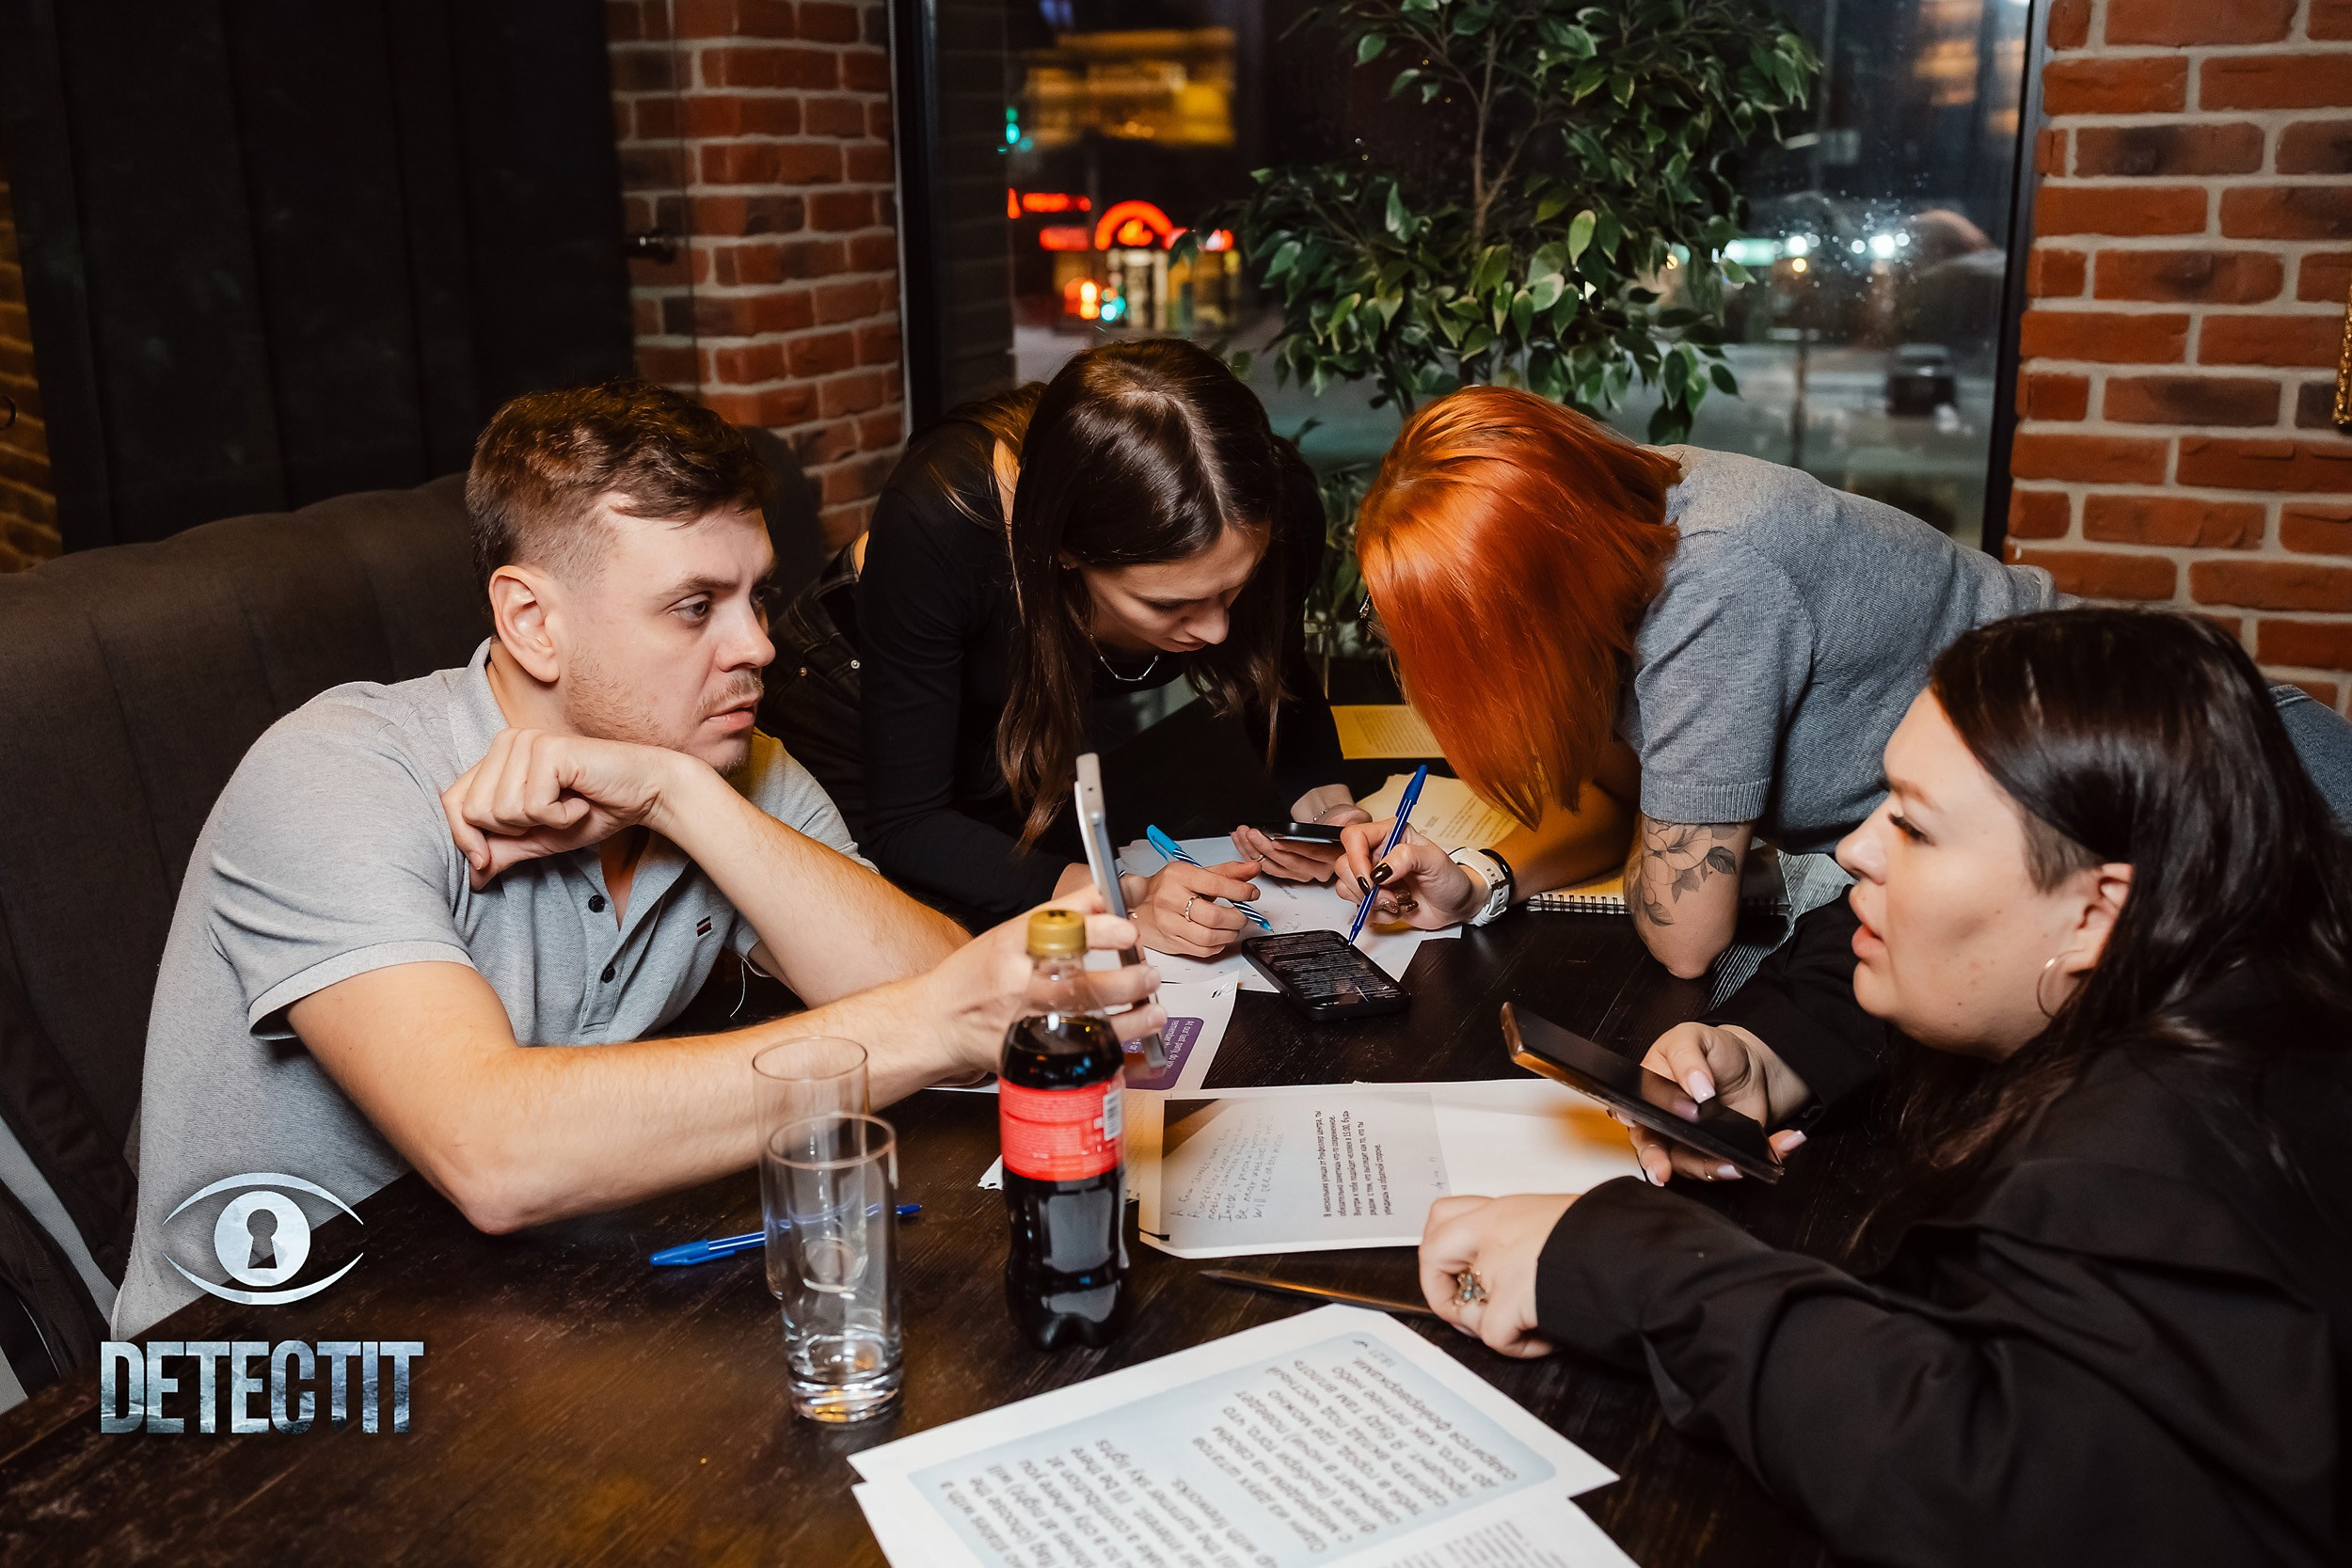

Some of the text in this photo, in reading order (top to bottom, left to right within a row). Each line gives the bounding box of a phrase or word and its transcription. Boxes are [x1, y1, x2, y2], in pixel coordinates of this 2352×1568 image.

[1164, 1021, 1180, 1042] remember
[1178, 1034, 1189, 1042] last
[1315, 1118, 1324, 1135] центра,
[1342, 1111, 1350, 1122] будь
[1329, 1116, 1339, 1147] современное.
[1342, 1124, 1350, 1136] 15:00,
[1317, 1135, 1327, 1160] Рокфеллер
[1345, 1142, 1354, 1159] человек
[1374, 1144, 1384, 1163] стороне.
[1320, 1166, 1329, 1182] улицах
[1334, 1162, 1343, 1183] заметишь
[1347, 1160, 1358, 1180] подойдет
[1361, 1152, 1371, 1173] выглядит
[1375, 1163, 1387, 1183] обратной
[1323, 1183, 1331, 1212] нескольких
[1348, 1181, 1359, 1193] тебе
[1235, 1209, 1249, 1220] Be
[1244, 1180, 1257, 1202] near
[1336, 1184, 1346, 1216] обязательно
[1353, 1197, 1362, 1215] Внутри
[1368, 1198, 1377, 1215] рядом
[1383, 1192, 1392, 1215] увидишь
[1294, 1360, 1470, 1498] процент. Я буду там вплоть
[1331, 1367, 1499, 1489] до того, как летнее небо
[1353, 1358, 1518, 1481] озарится фейерверками.
[1264, 1366, 1448, 1507] сделать вклад под честный
[1045, 1456, 1065, 1468] at
[1071, 1447, 1104, 1475] there
[1095, 1439, 1131, 1470] lights
[1234, 1391, 1401, 1525] сверкает в ночи) поведет
[1267, 1390, 1422, 1516] тебя в город, где можно
[986, 1465, 1013, 1484] will
[1099, 1474, 1120, 1491] be
[1127, 1469, 1152, 1488] sky
[1222, 1406, 1377, 1534] флаге (выбери того, что
[940, 1481, 954, 1489] a
[969, 1478, 992, 1497] the
[1192, 1437, 1327, 1553] Один из двух штатов
[1212, 1426, 1353, 1544] с медведем на своём
[947, 1491, 976, 1516] with
[1005, 1484, 1046, 1518] night)
[1019, 1460, 1122, 1561] to a city where you
[1060, 1469, 1131, 1533] contribution
[1146, 1489, 1200, 1533] summer
[1171, 1478, 1229, 1529] fireworks.
[986, 1497, 1038, 1543] (choose
[1039, 1518, 1059, 1530] at
[1133, 1507, 1184, 1552] interest.
[970, 1516, 1010, 1553] states
[1126, 1533, 1140, 1543] a
[1196, 1533, 1222, 1555] the
[1226, 1528, 1258, 1554] with
